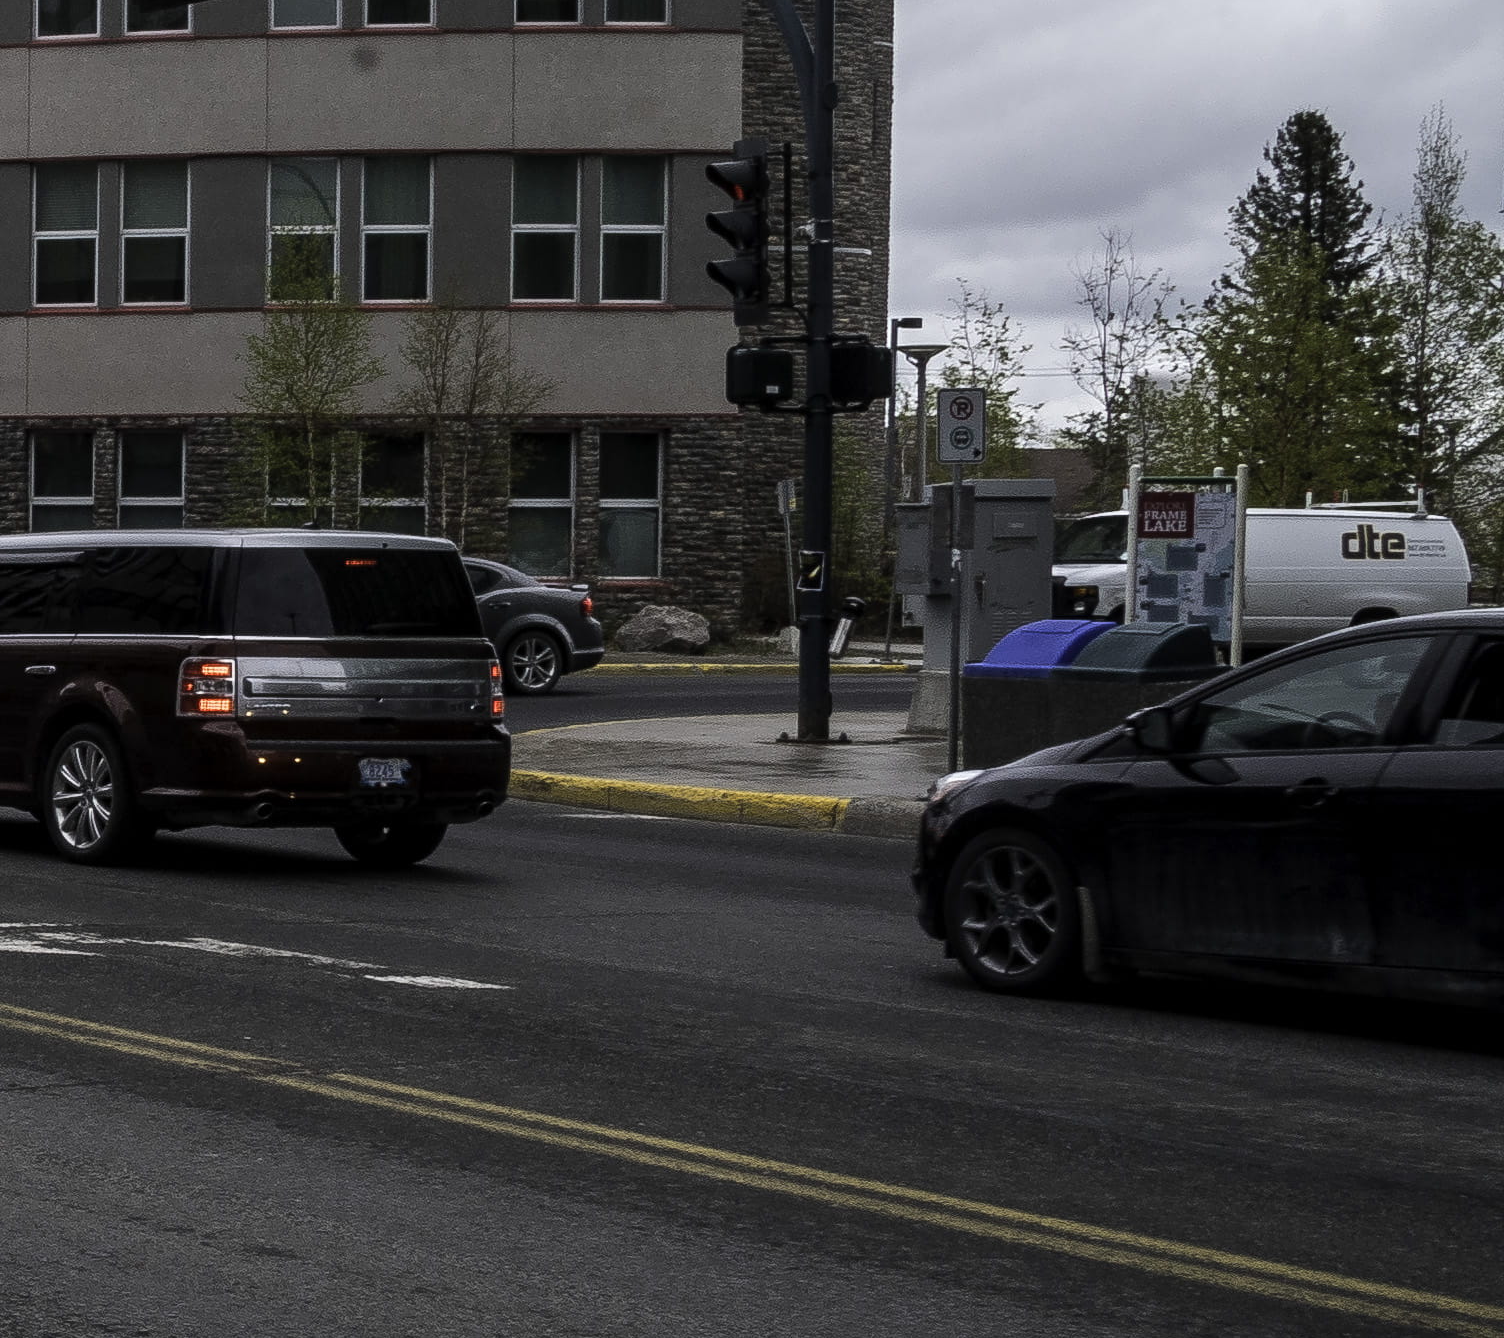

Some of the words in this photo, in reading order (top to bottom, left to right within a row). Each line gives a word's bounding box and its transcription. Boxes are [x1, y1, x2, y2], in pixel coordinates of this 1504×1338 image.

[1143, 510, 1187, 521] FRAME
[1143, 520, 1187, 532] LAKE
[1341, 524, 1406, 560] dte
